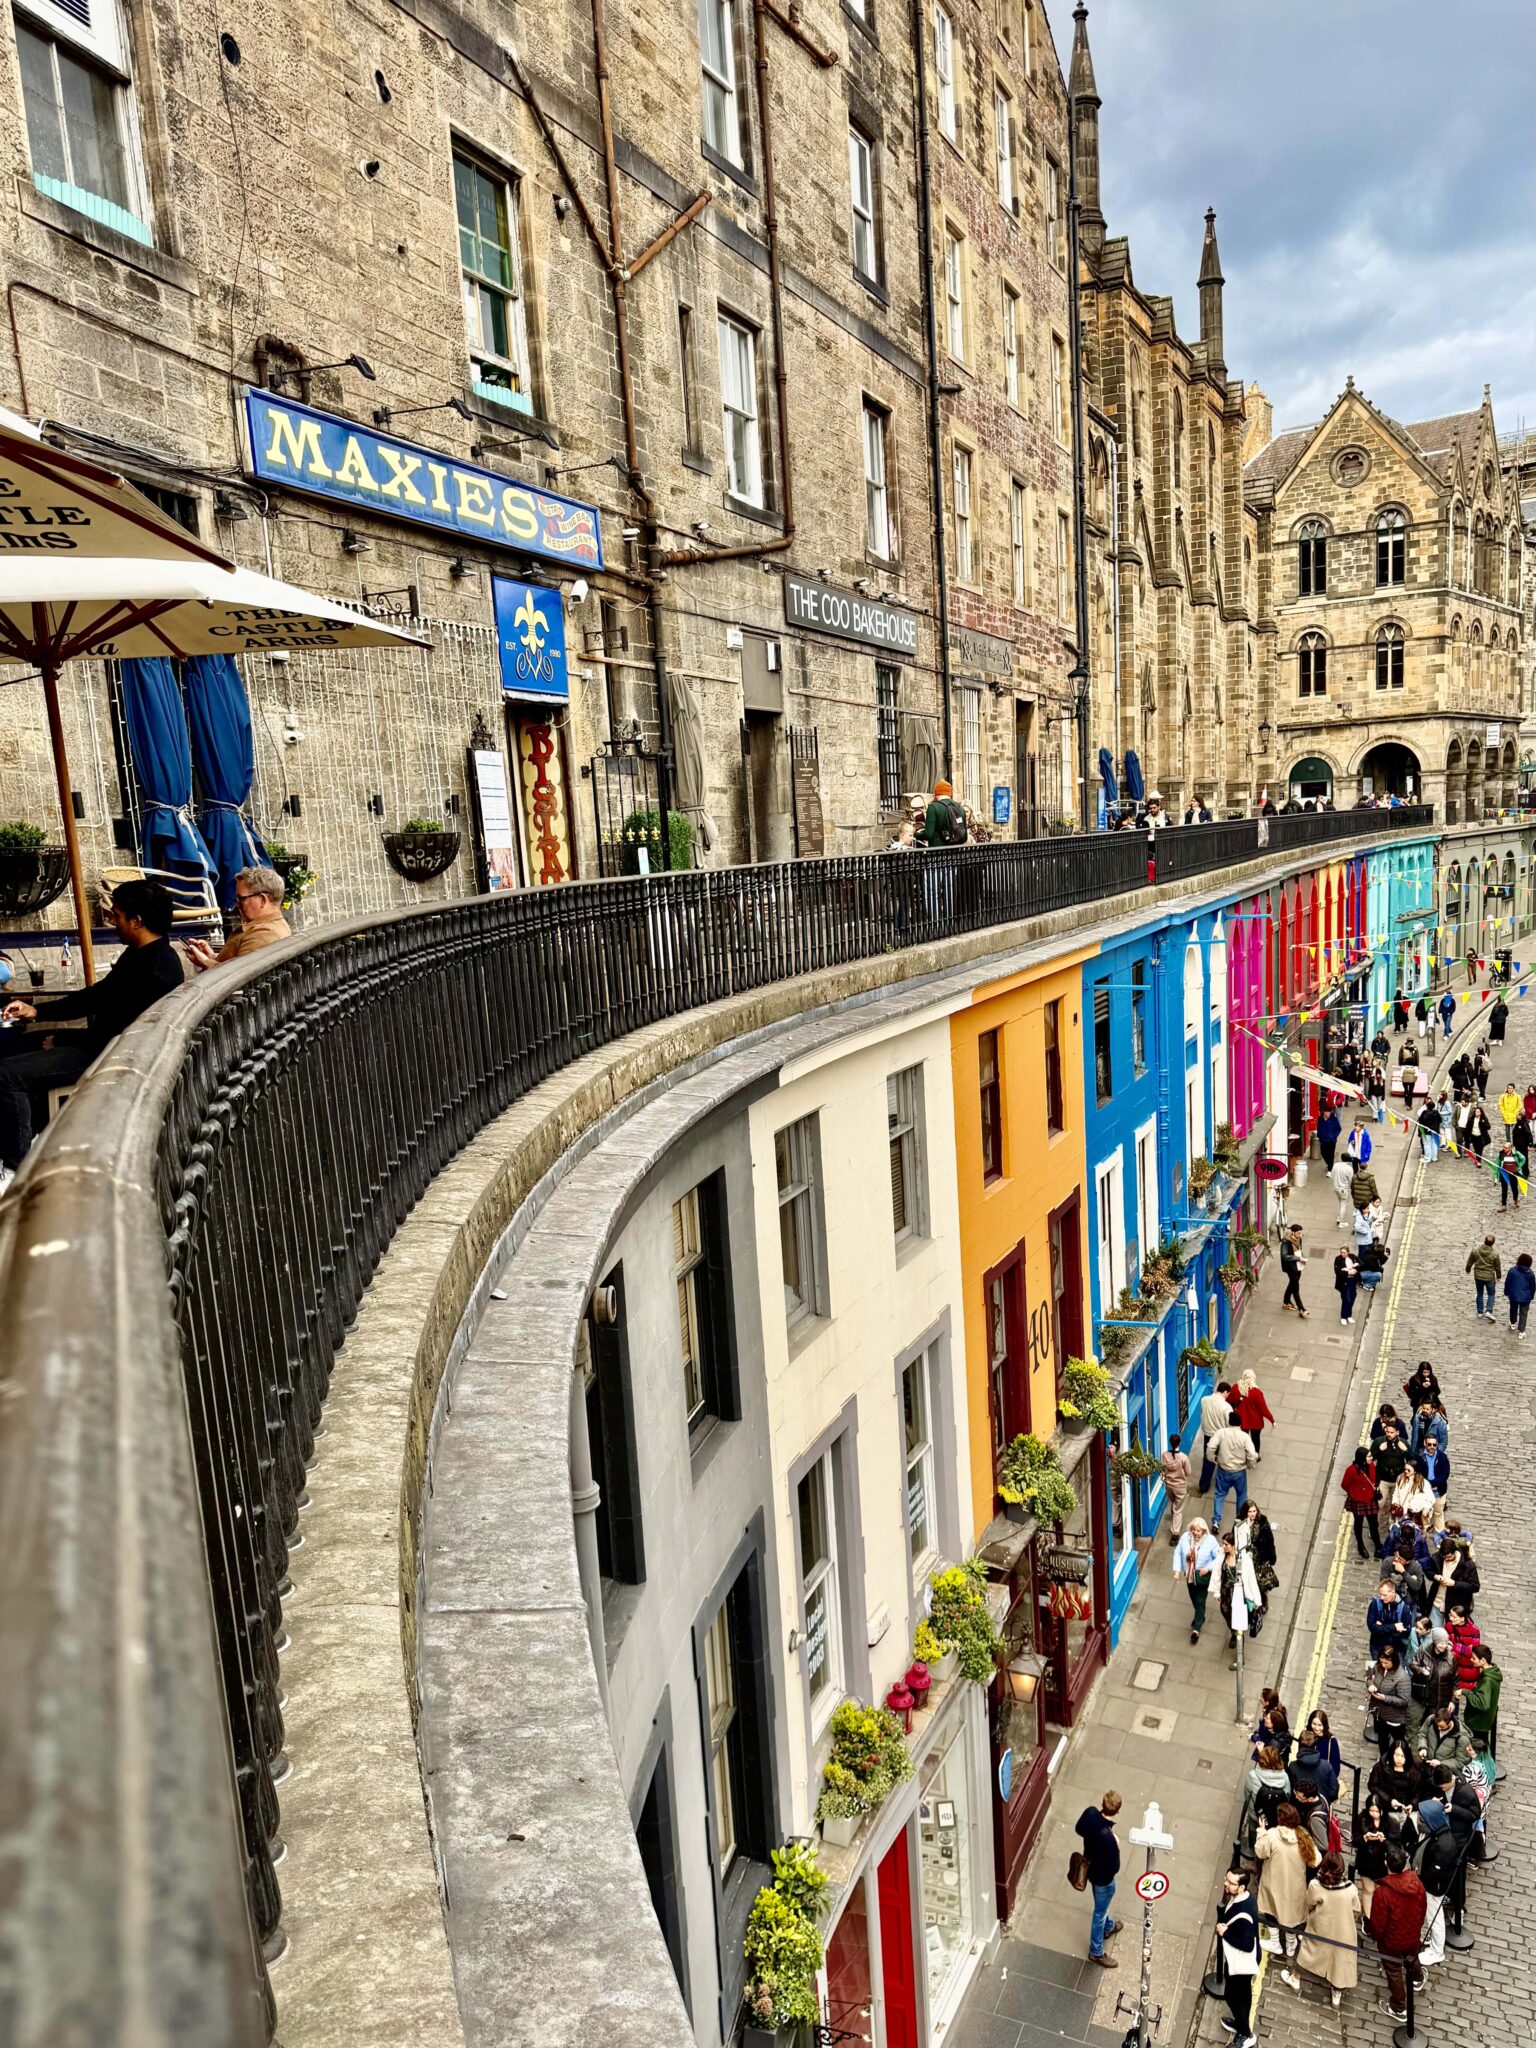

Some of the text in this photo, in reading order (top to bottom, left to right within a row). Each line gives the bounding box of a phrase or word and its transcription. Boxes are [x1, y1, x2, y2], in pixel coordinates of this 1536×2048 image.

[265, 408, 539, 540] MAXIES
[540, 505, 564, 516] BISTRO
[561, 512, 591, 531] WINE BAR
[546, 535, 596, 549] RESTAURANT
[790, 583, 916, 647] THE COO BAKEHOUSE
[208, 619, 347, 637] CASTLE
[505, 641, 518, 651] EST.
[1028, 1300, 1050, 1374] 40
